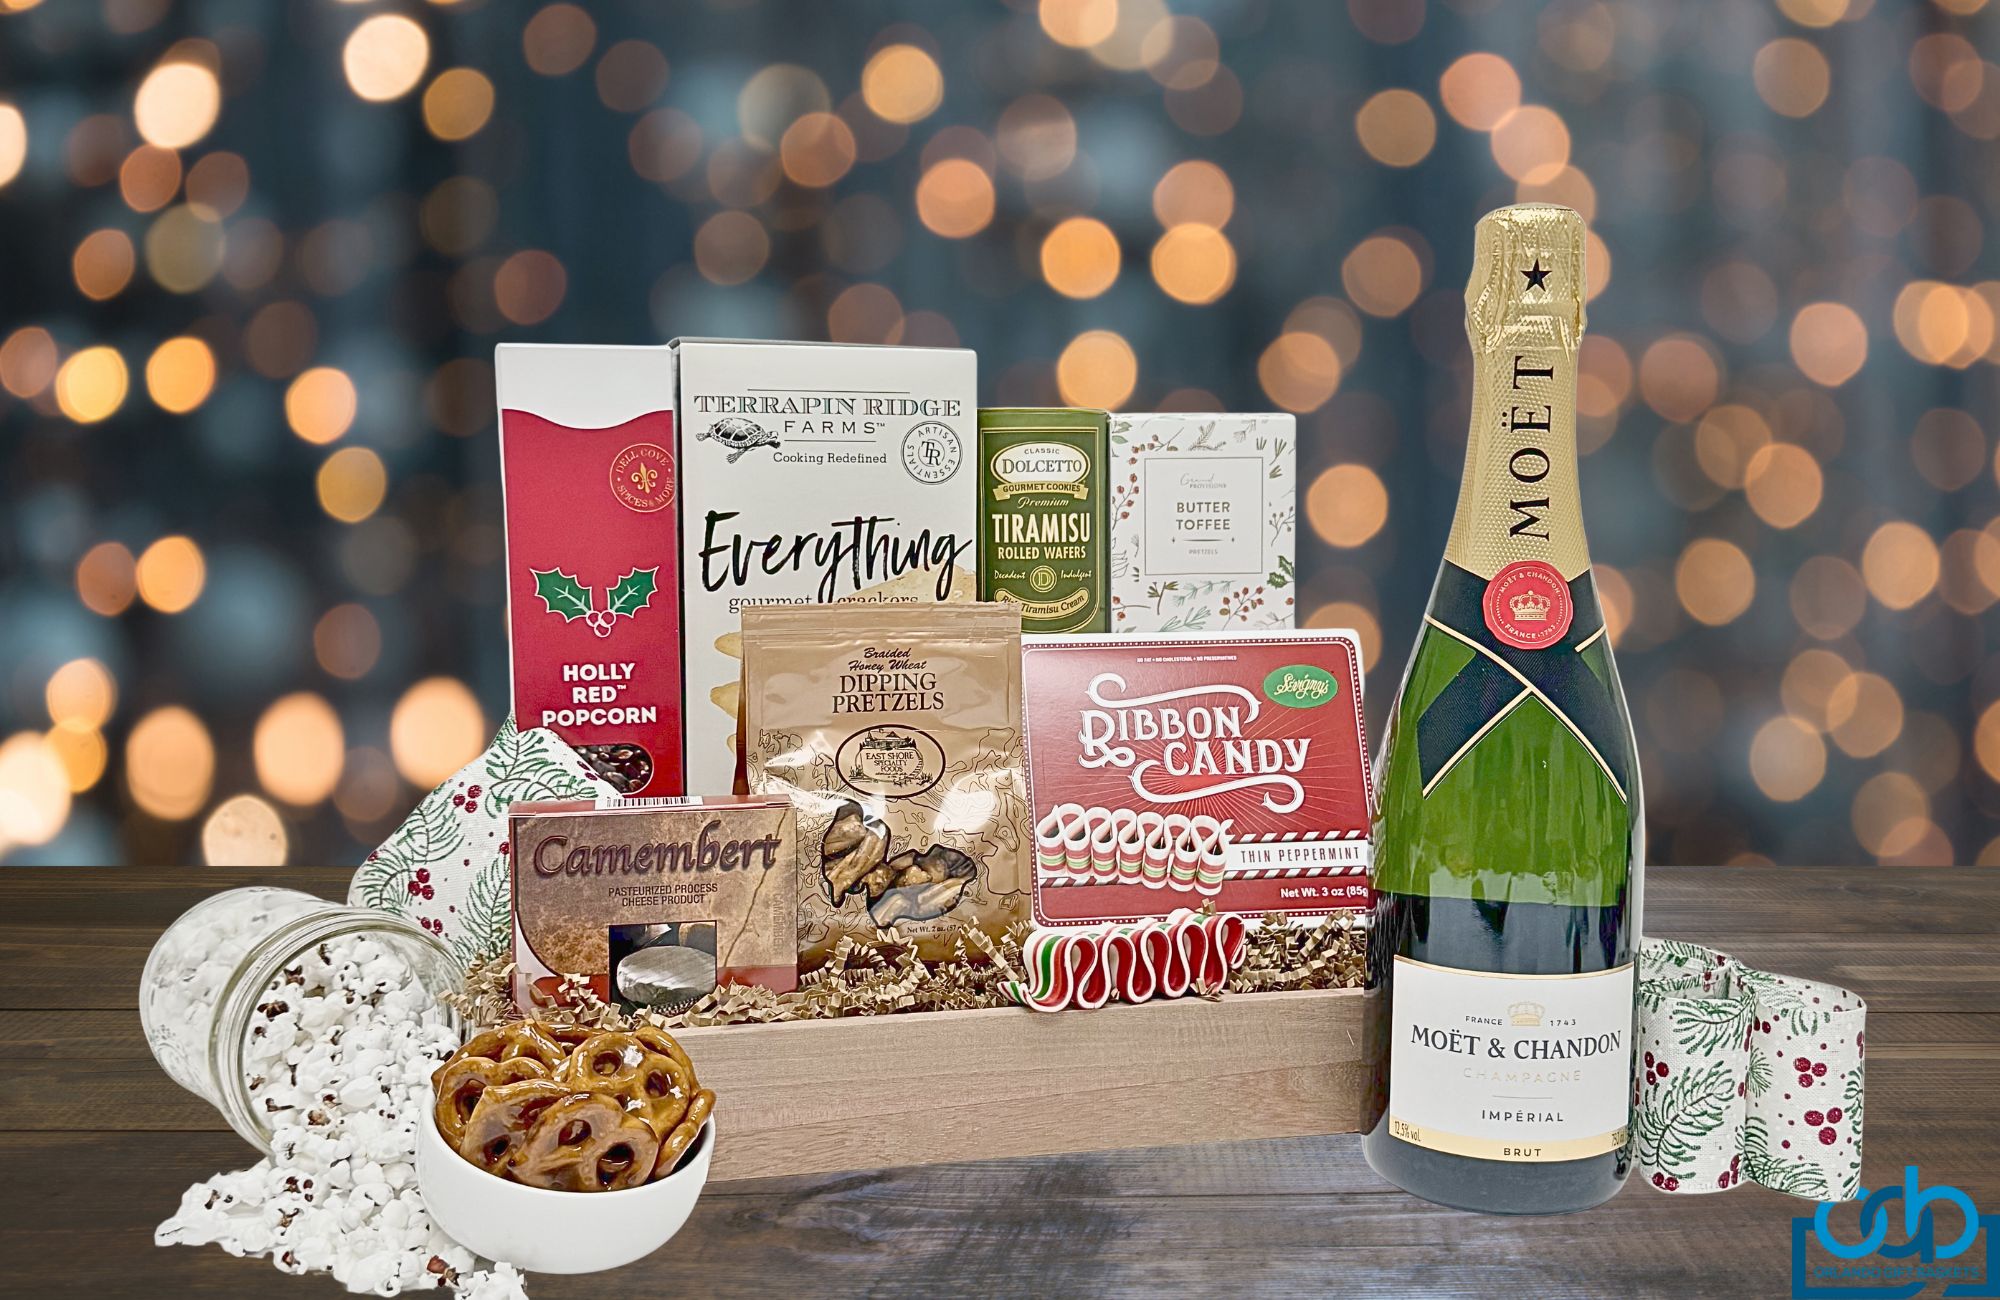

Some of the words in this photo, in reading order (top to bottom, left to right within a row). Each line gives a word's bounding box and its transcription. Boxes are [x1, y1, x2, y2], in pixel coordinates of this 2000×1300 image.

[694, 395, 856, 415] TERRAPIN
[863, 399, 961, 417] RIDGE
[918, 426, 957, 453] ARTISAN
[1501, 355, 1554, 541] MOËT
[616, 451, 639, 473] DELL
[641, 449, 669, 466] COVE
[773, 452, 824, 465] Cooking
[827, 452, 887, 464] Redefined
[907, 444, 956, 479] ESSENTIALS
[1002, 458, 1082, 474] DOLCETTO
[1003, 484, 1045, 493] GOURMET
[1047, 483, 1080, 492] COOKIES
[1017, 496, 1069, 509] Premium
[1176, 501, 1231, 513] BUTTER
[991, 513, 1091, 543] TIRAMISU
[1175, 519, 1231, 531] TOFFEE
[698, 510, 973, 603] Everything
[998, 547, 1040, 560] ROLLED
[1044, 546, 1086, 559] WAFERS
[994, 570, 1026, 579] Decadent
[1060, 569, 1092, 581] Indulgent
[1526, 571, 1560, 594] CHANDON
[1021, 603, 1059, 614] Tiramisu
[1060, 595, 1085, 611] Cream
[1504, 623, 1536, 639] FRANCE
[863, 647, 912, 659] Braided
[563, 663, 635, 681] HOLLY
[848, 660, 884, 673] Honey
[888, 659, 927, 670] Wheat
[840, 673, 936, 693] DIPPING
[832, 692, 944, 713] PRETZELS
[542, 706, 657, 727] POPCORN
[1079, 706, 1242, 768] RIBBON
[1163, 738, 1312, 776] CANDY
[533, 820, 782, 878] Camembert
[1241, 850, 1271, 863] THIN
[1278, 847, 1359, 861] PEPPERMINT
[608, 885, 672, 896] PASTEURIZED
[674, 883, 718, 894] PROCESS
[1280, 888, 1299, 898] Net
[1301, 887, 1319, 897] Wt.
[1321, 888, 1328, 896] 3
[1331, 888, 1344, 896] oz
[622, 896, 659, 906] CHEESE
[661, 894, 705, 905] PRODUCT
[1465, 1015, 1503, 1026] FRANCE
[1550, 1019, 1577, 1027] 1743
[1411, 1024, 1481, 1056] MOËT
[1487, 1038, 1506, 1059] &
[1513, 1030, 1622, 1060] CHANDON
[1463, 1067, 1582, 1083] CHAMPAGNE
[1482, 1109, 1564, 1122] IMPÉRIAL
[1503, 1147, 1542, 1157] BRUT
